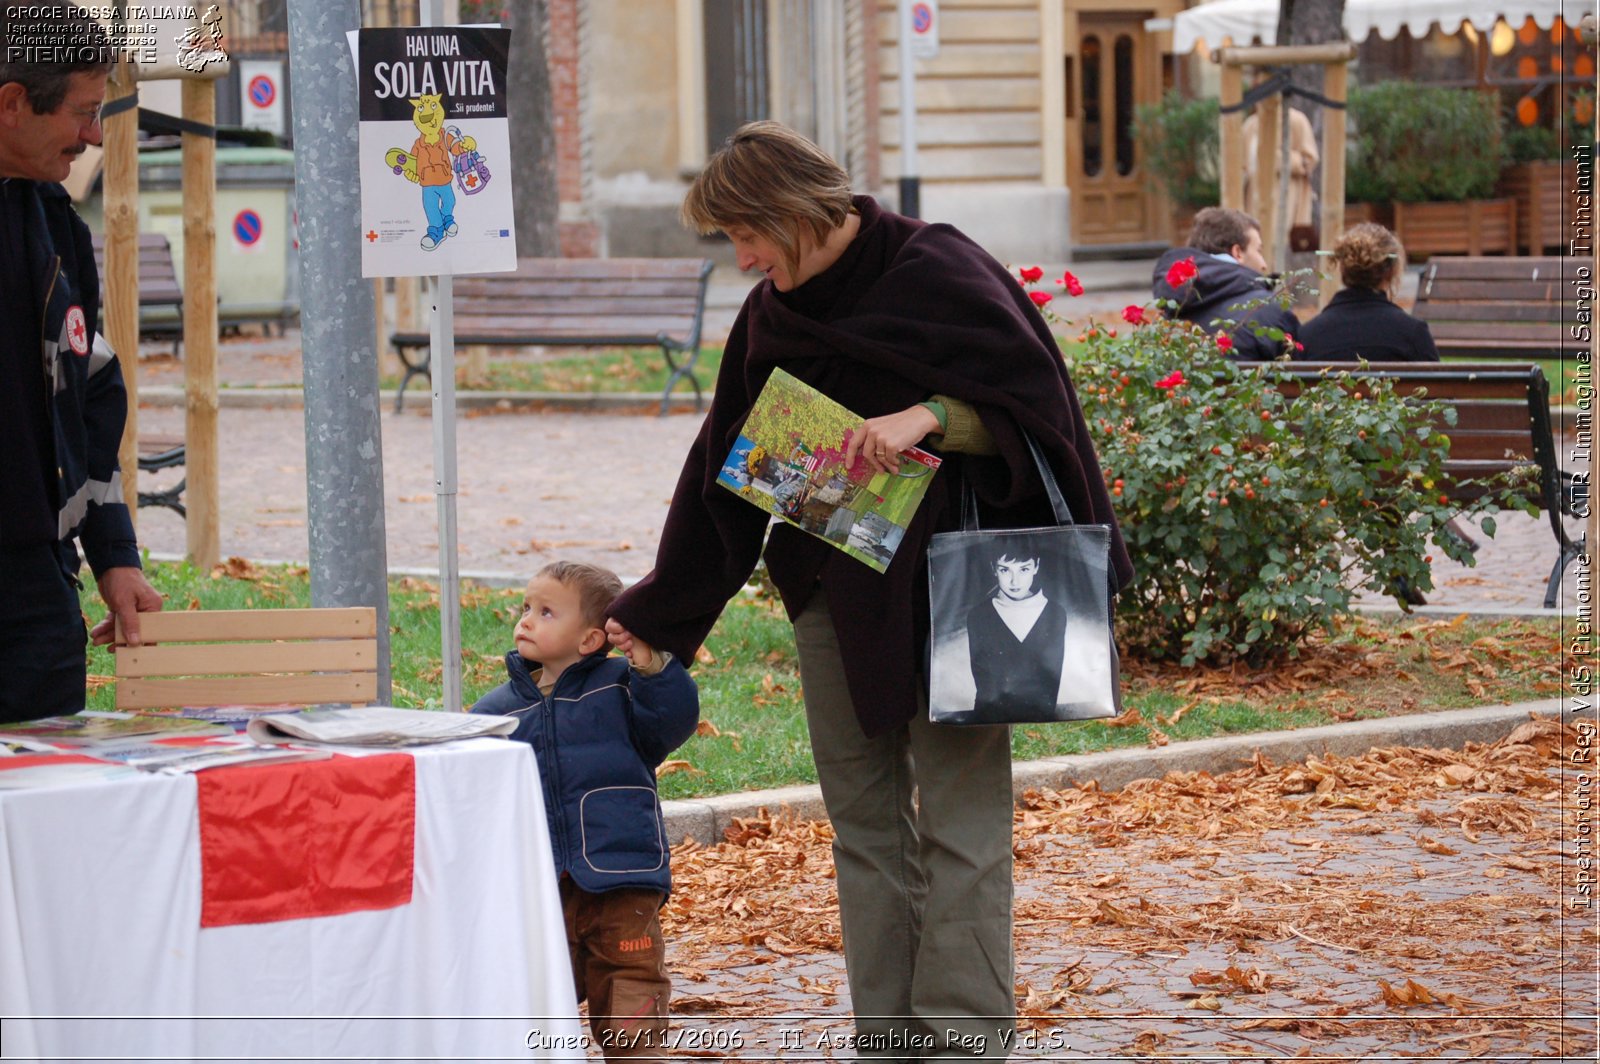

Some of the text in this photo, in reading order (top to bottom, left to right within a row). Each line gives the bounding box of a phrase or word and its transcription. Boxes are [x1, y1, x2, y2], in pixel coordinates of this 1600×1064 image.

[406, 35, 460, 56] HAI UNA
[374, 60, 496, 99] SOLA VITA
[466, 102, 495, 115] prudente!
